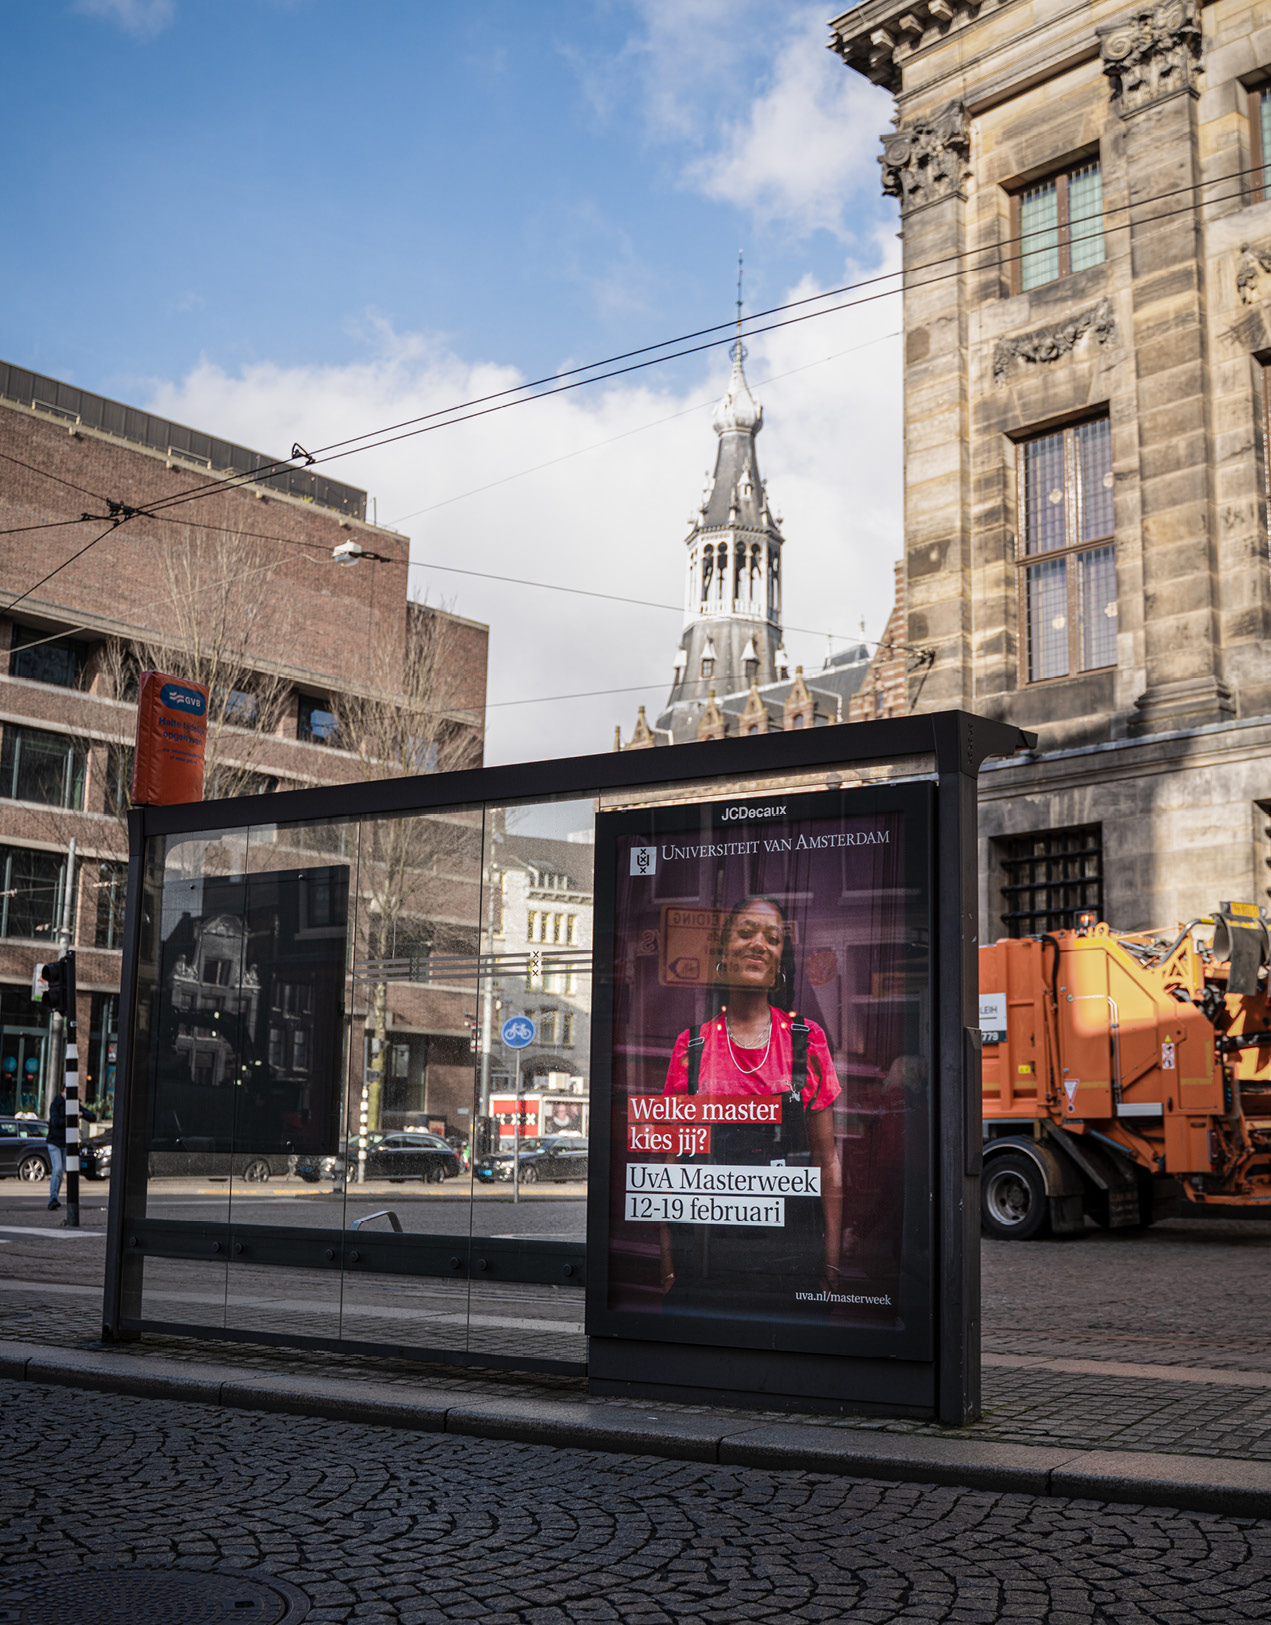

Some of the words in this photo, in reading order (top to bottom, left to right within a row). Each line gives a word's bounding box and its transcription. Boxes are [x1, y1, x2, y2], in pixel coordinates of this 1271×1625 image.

[185, 696, 201, 707] GVB
[721, 805, 787, 821] JCDecaux
[630, 1097, 697, 1121] Welke
[701, 1100, 780, 1121] master
[629, 1126, 673, 1151] kies
[676, 1128, 708, 1158] jij?
[629, 1166, 675, 1189] UvA
[679, 1167, 819, 1193] Masterweek
[630, 1197, 685, 1220] 12-19
[690, 1197, 782, 1224] februari
[795, 1290, 893, 1306] uva.nl/masterweek
